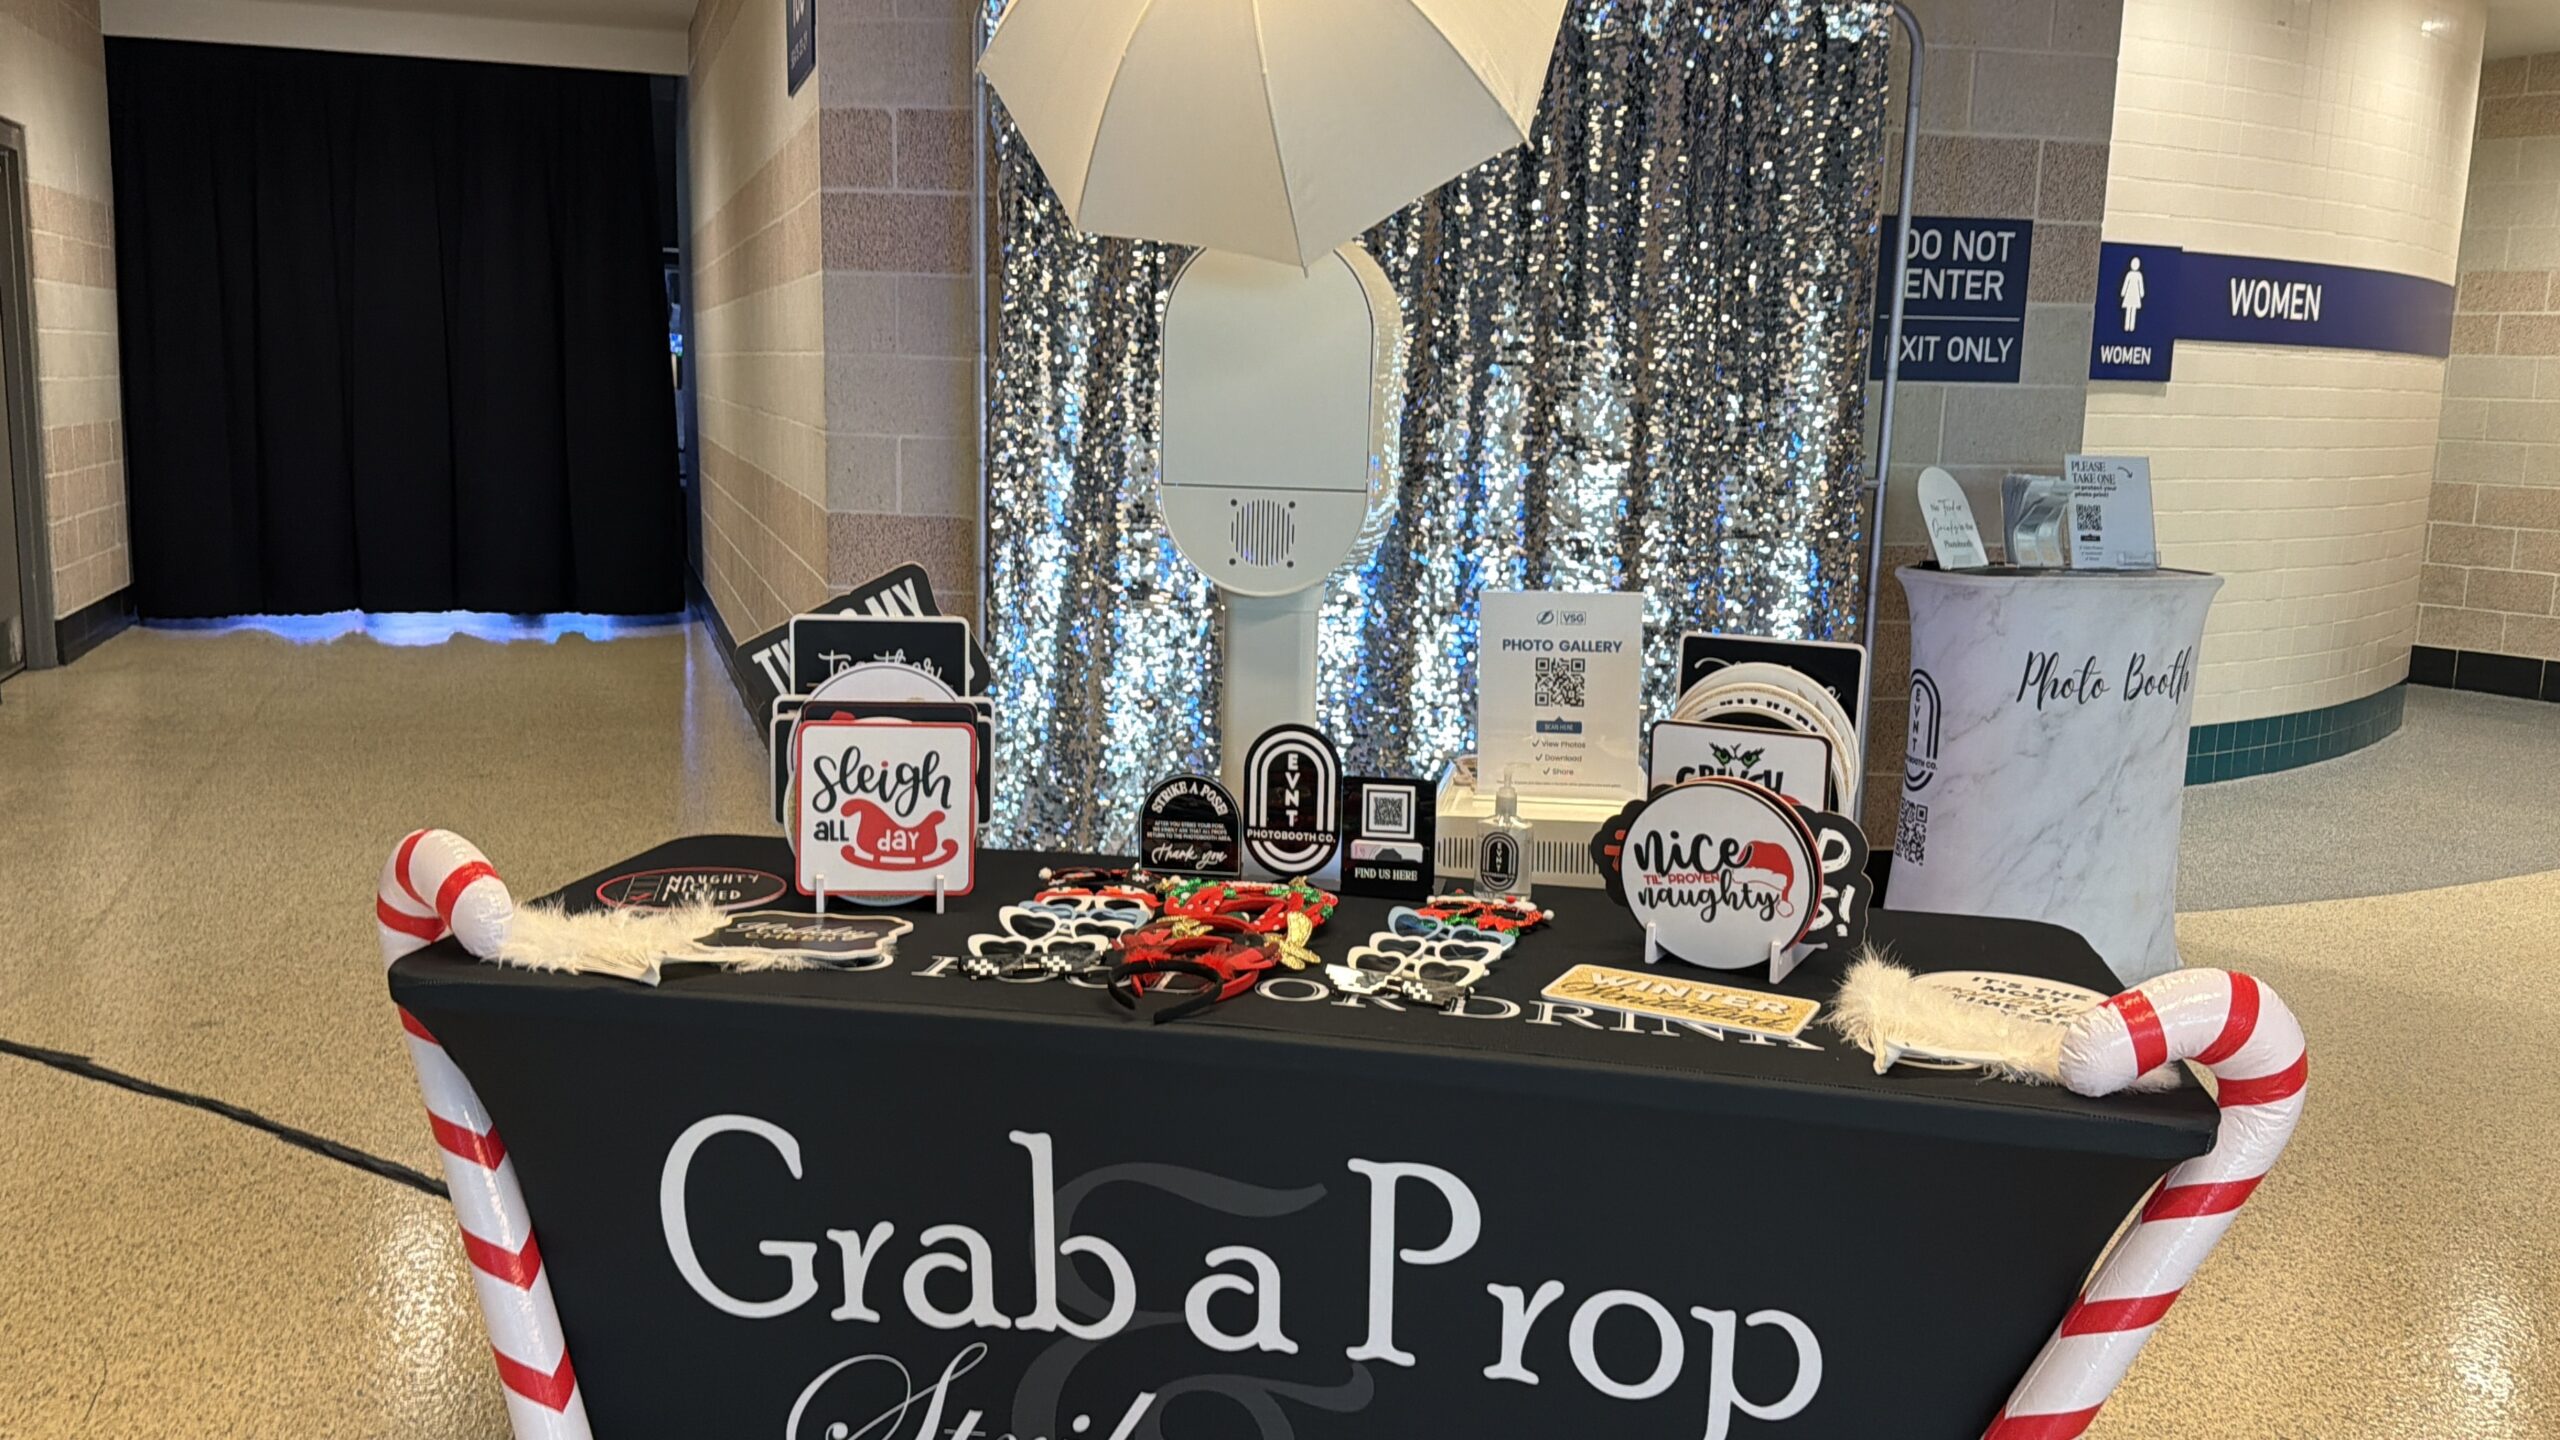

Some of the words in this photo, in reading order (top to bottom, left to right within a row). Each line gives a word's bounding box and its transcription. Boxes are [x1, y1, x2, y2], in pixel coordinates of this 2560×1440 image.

[1907, 229, 1942, 260] DO
[1952, 230, 2016, 262] NOT
[1904, 268, 2004, 301] ENTER
[2230, 277, 2321, 322] WOMEN
[1883, 334, 1941, 362] XIT
[1947, 336, 2014, 363] ONLY
[2100, 345, 2151, 365] WOMEN
[2071, 461, 2106, 472] PLEASE
[2073, 473, 2096, 483] TAKE
[2097, 474, 2116, 485] ONE
[1563, 614, 1584, 623] VSG
[1502, 639, 1554, 652] PHOTO
[1559, 640, 1623, 653] GALLERY
[2016, 650, 2111, 711] Photo
[2124, 645, 2192, 705] Booth
[1561, 741, 1586, 749] Photos
[1545, 755, 1582, 763] Download
[1552, 768, 1574, 776] Share
[1151, 781, 1188, 814] STRIKE
[1189, 781, 1198, 795] A
[1285, 753, 1300, 827] EVNT
[1247, 829, 1316, 841] PHOTOBOOTH
[1151, 843, 1198, 864] Thank
[1196, 850, 1228, 870] you
[669, 873, 759, 884] NAUGHTY
[1355, 867, 1377, 879] FIND
[1378, 868, 1391, 880] US
[1392, 869, 1418, 881] HERE
[1668, 872, 1720, 885] PROVEN
[1638, 868, 1780, 923] naughty
[1591, 970, 1790, 1015] WINTER
[1972, 976, 2022, 988] IT'S
[2035, 986, 2092, 1002] THE
[1981, 985, 2067, 1003] MOST
[1561, 981, 1792, 1029] Wonderland
[660, 1114, 1136, 1340] Grab
[1185, 1245, 1299, 1354] a
[1346, 1158, 1823, 1440] Prop
